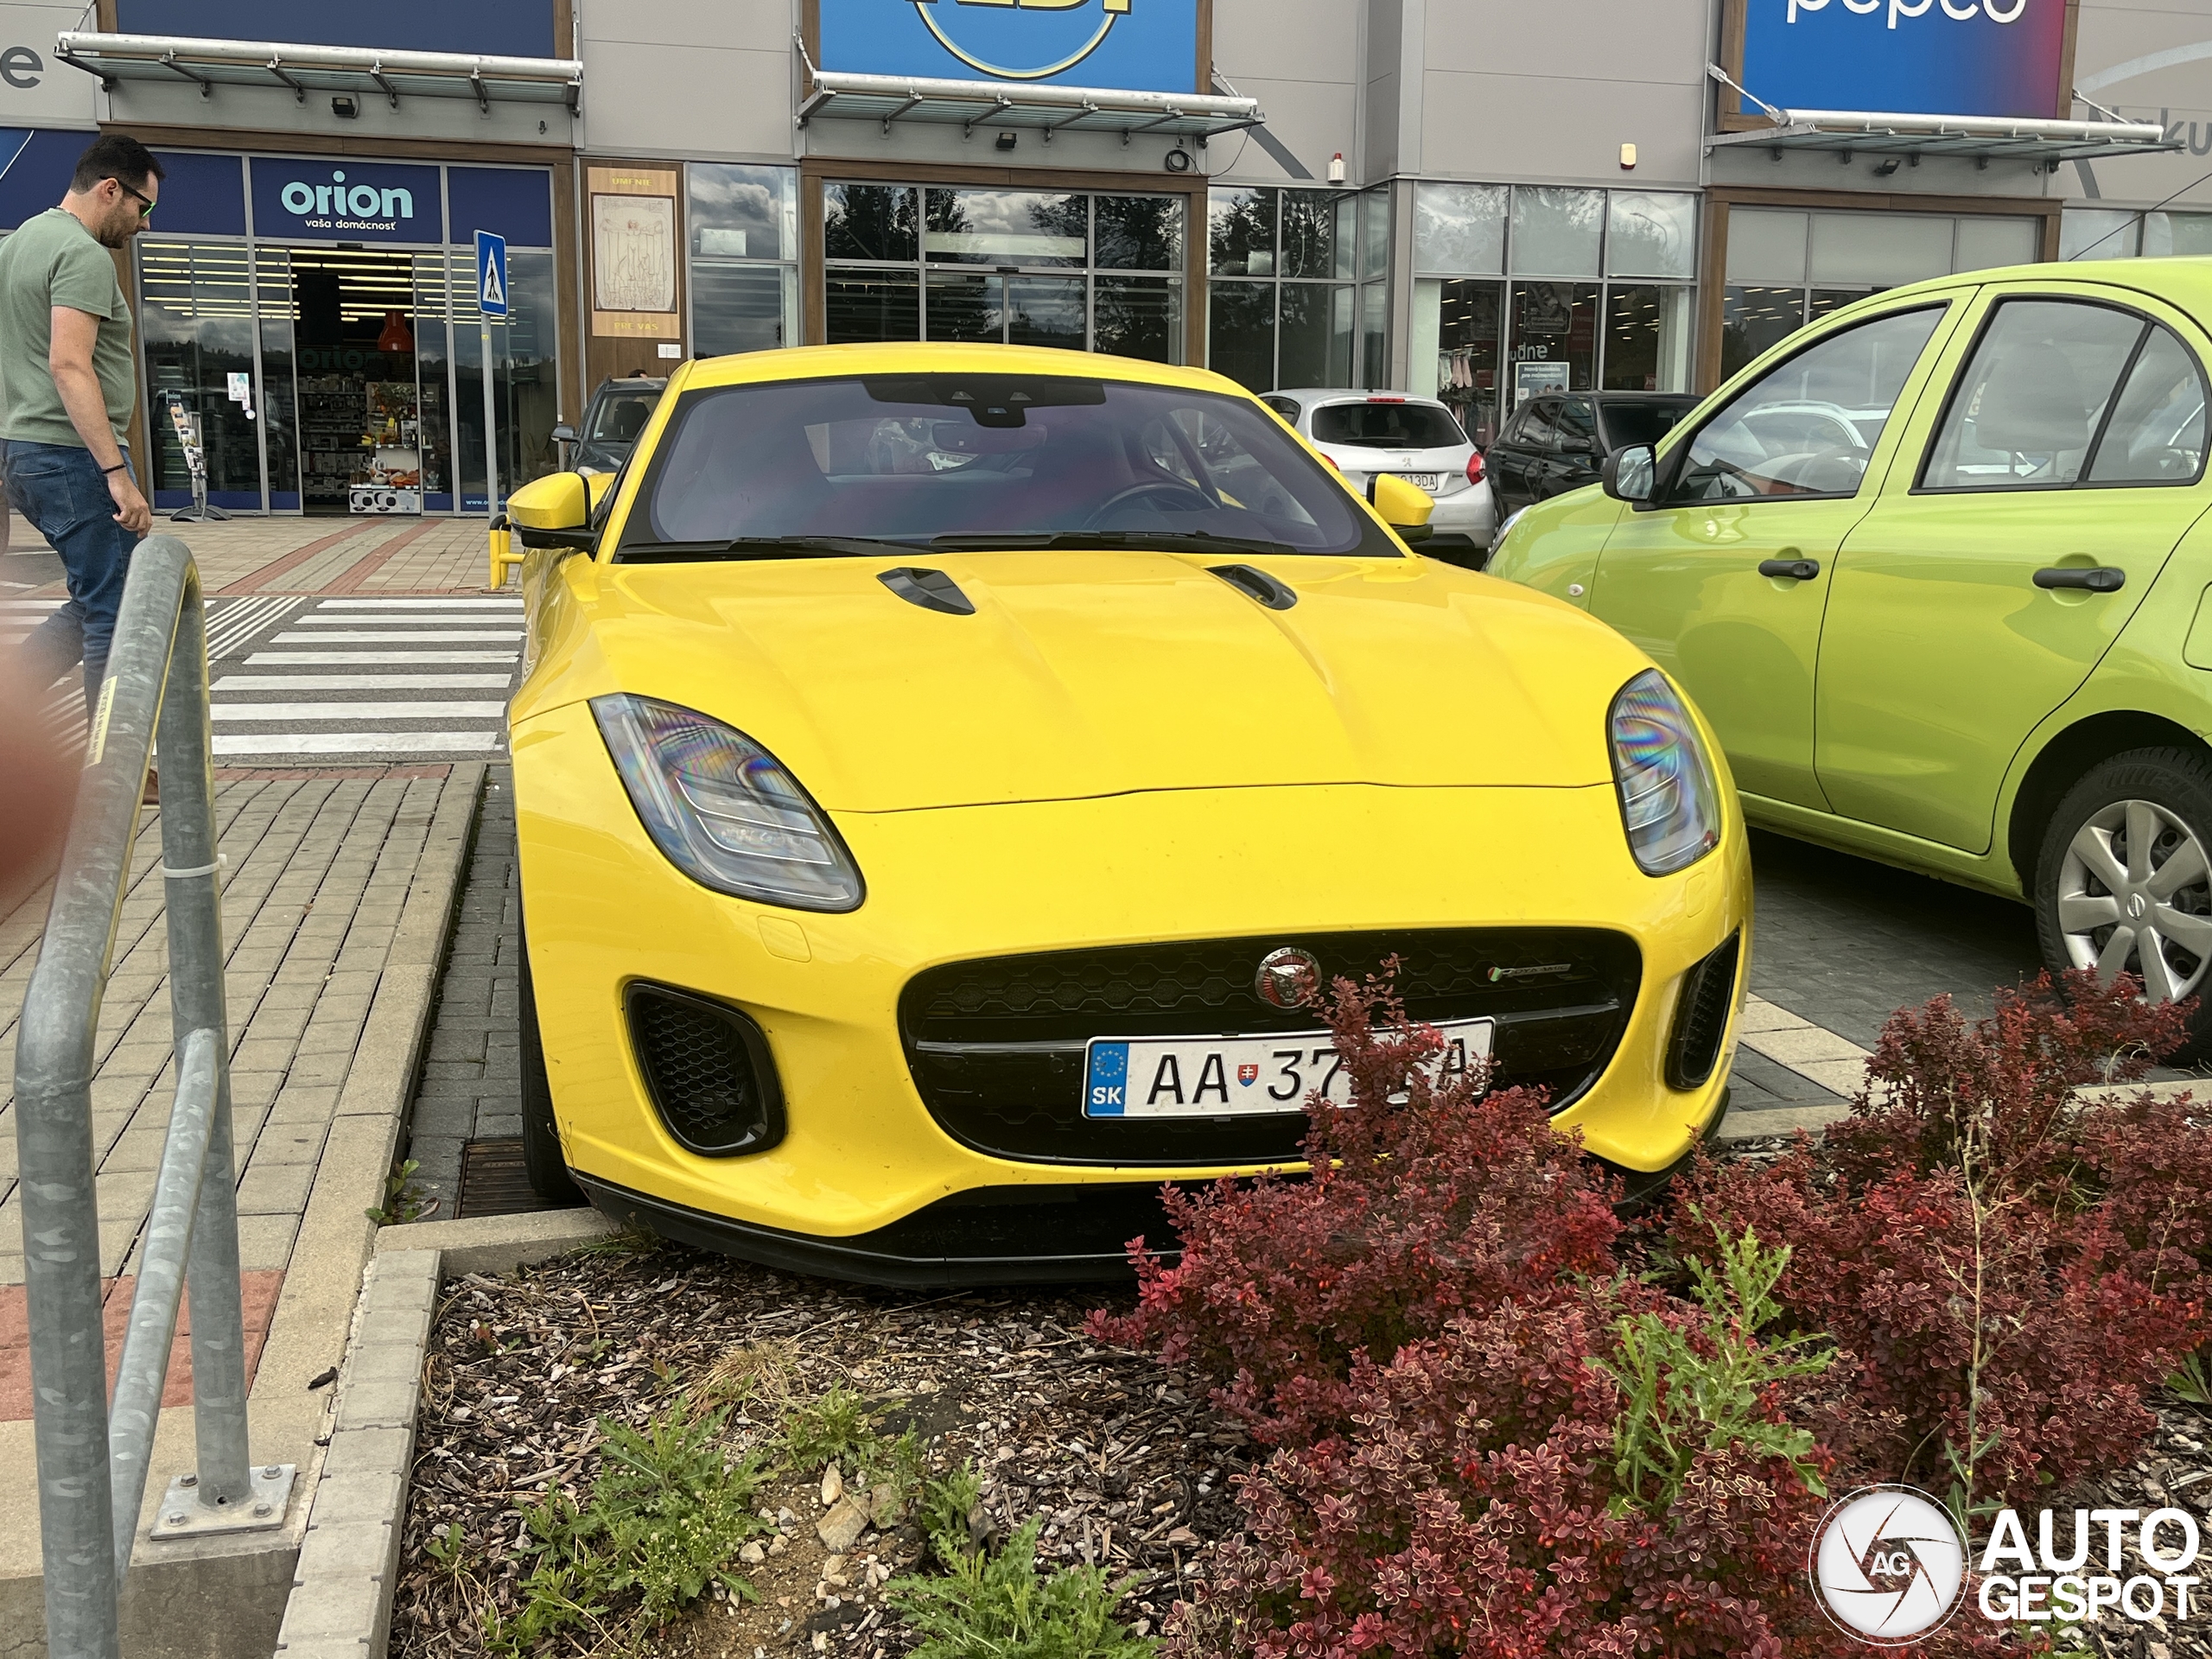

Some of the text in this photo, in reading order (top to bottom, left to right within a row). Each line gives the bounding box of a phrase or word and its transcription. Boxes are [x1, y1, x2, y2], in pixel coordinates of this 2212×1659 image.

[281, 170, 413, 219] orion
[305, 219, 397, 231] vaša domácnosť
[1092, 1086, 1122, 1105] SK
[1147, 1053, 1229, 1105] AA
